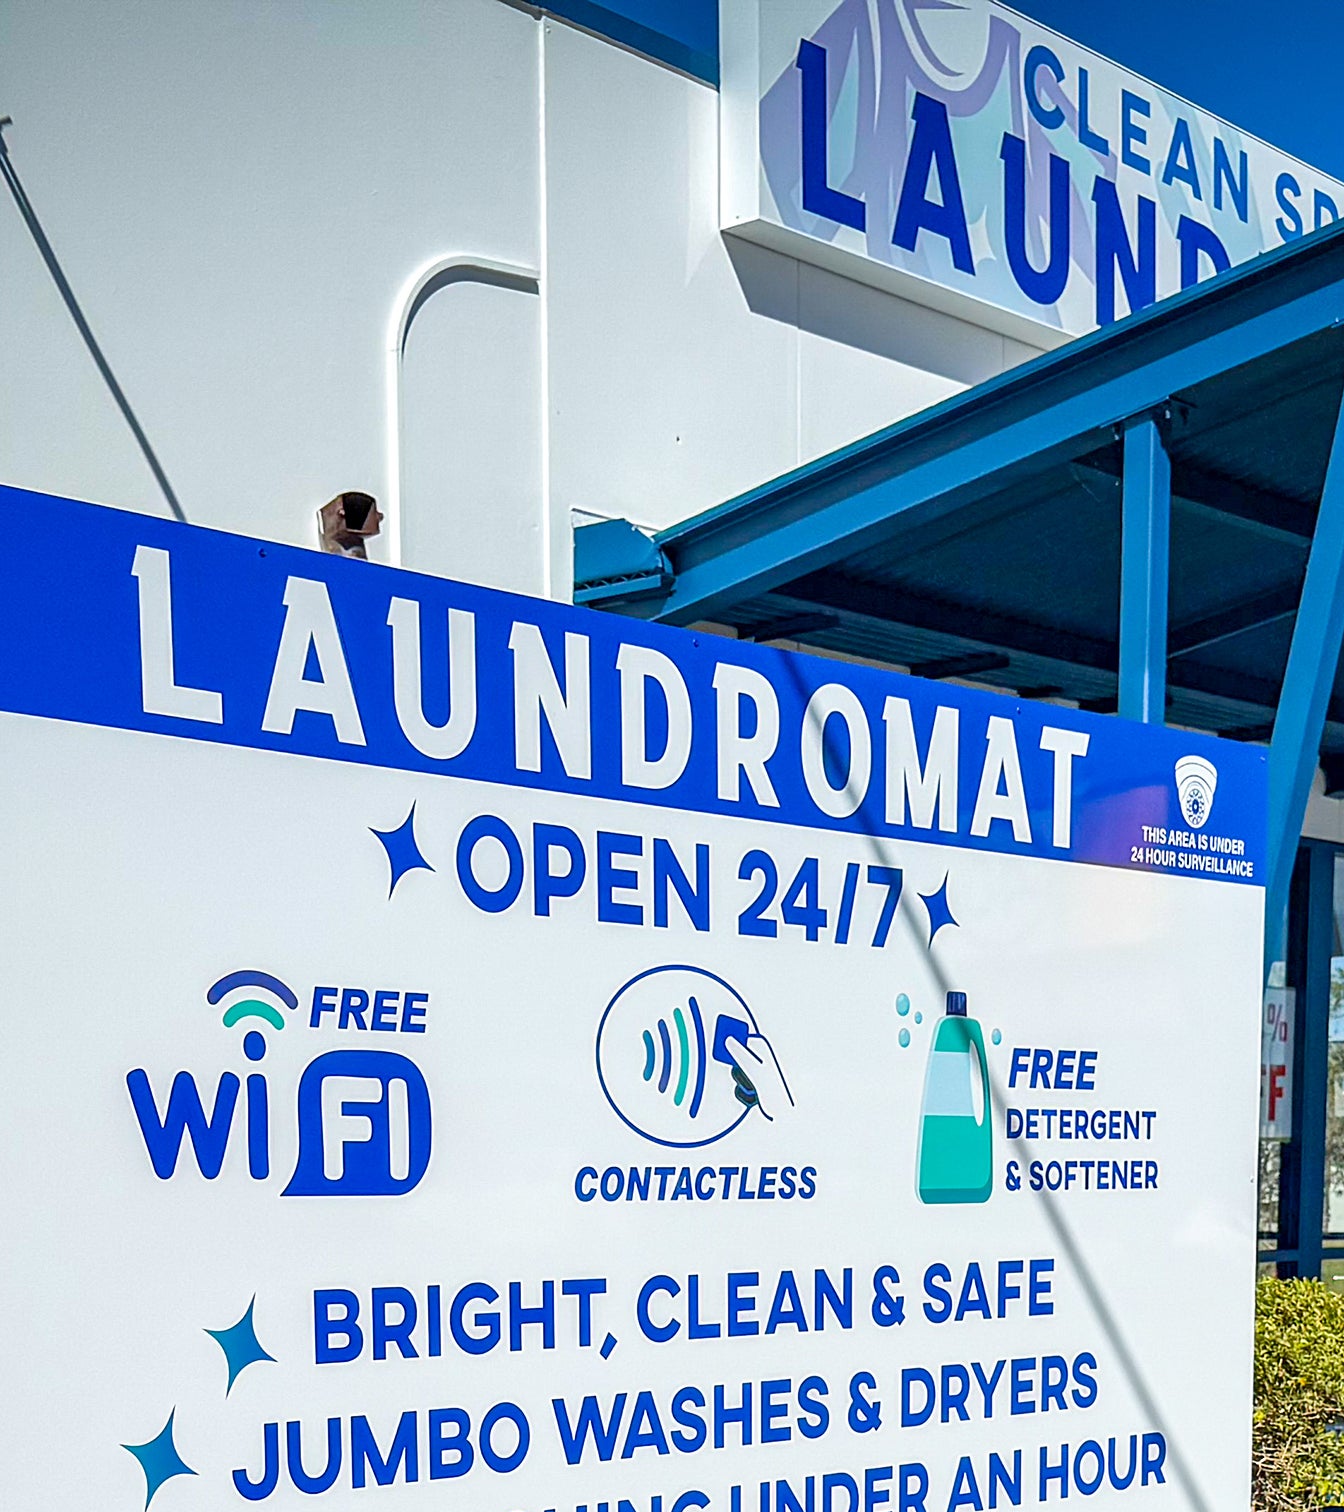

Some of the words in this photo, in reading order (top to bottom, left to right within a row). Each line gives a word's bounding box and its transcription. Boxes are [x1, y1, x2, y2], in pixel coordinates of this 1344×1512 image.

[1023, 43, 1249, 224] CLEAN
[131, 544, 1091, 849] LAUNDROMAT
[1130, 846, 1144, 864] 24
[1145, 848, 1176, 867] HOUR
[1177, 852, 1254, 878] SURVEILLANCE
[1141, 825, 1167, 845] THIS
[1168, 830, 1197, 850] AREA
[1198, 834, 1209, 851] IS
[1209, 836, 1245, 856] UNDER
[455, 814, 711, 933] OPEN
[737, 848, 904, 949] 24/7
[309, 986, 429, 1035] FREE
[1008, 1047, 1099, 1091] FREE
[1006, 1108, 1158, 1142] DETERGENT
[574, 1166, 817, 1203] CONTACTLESS
[1005, 1160, 1022, 1192] &
[1029, 1160, 1159, 1193] SOFTENER
[313, 1277, 618, 1365] BRIGHT,
[636, 1267, 854, 1344] CLEAN
[871, 1265, 906, 1328] &
[922, 1258, 1055, 1325] SAFE
[232, 1401, 531, 1502] JUMBO
[552, 1375, 830, 1466] WASHES
[847, 1371, 882, 1434] &
[900, 1351, 1099, 1428] DRYERS
[1038, 1431, 1167, 1502] HOUR
